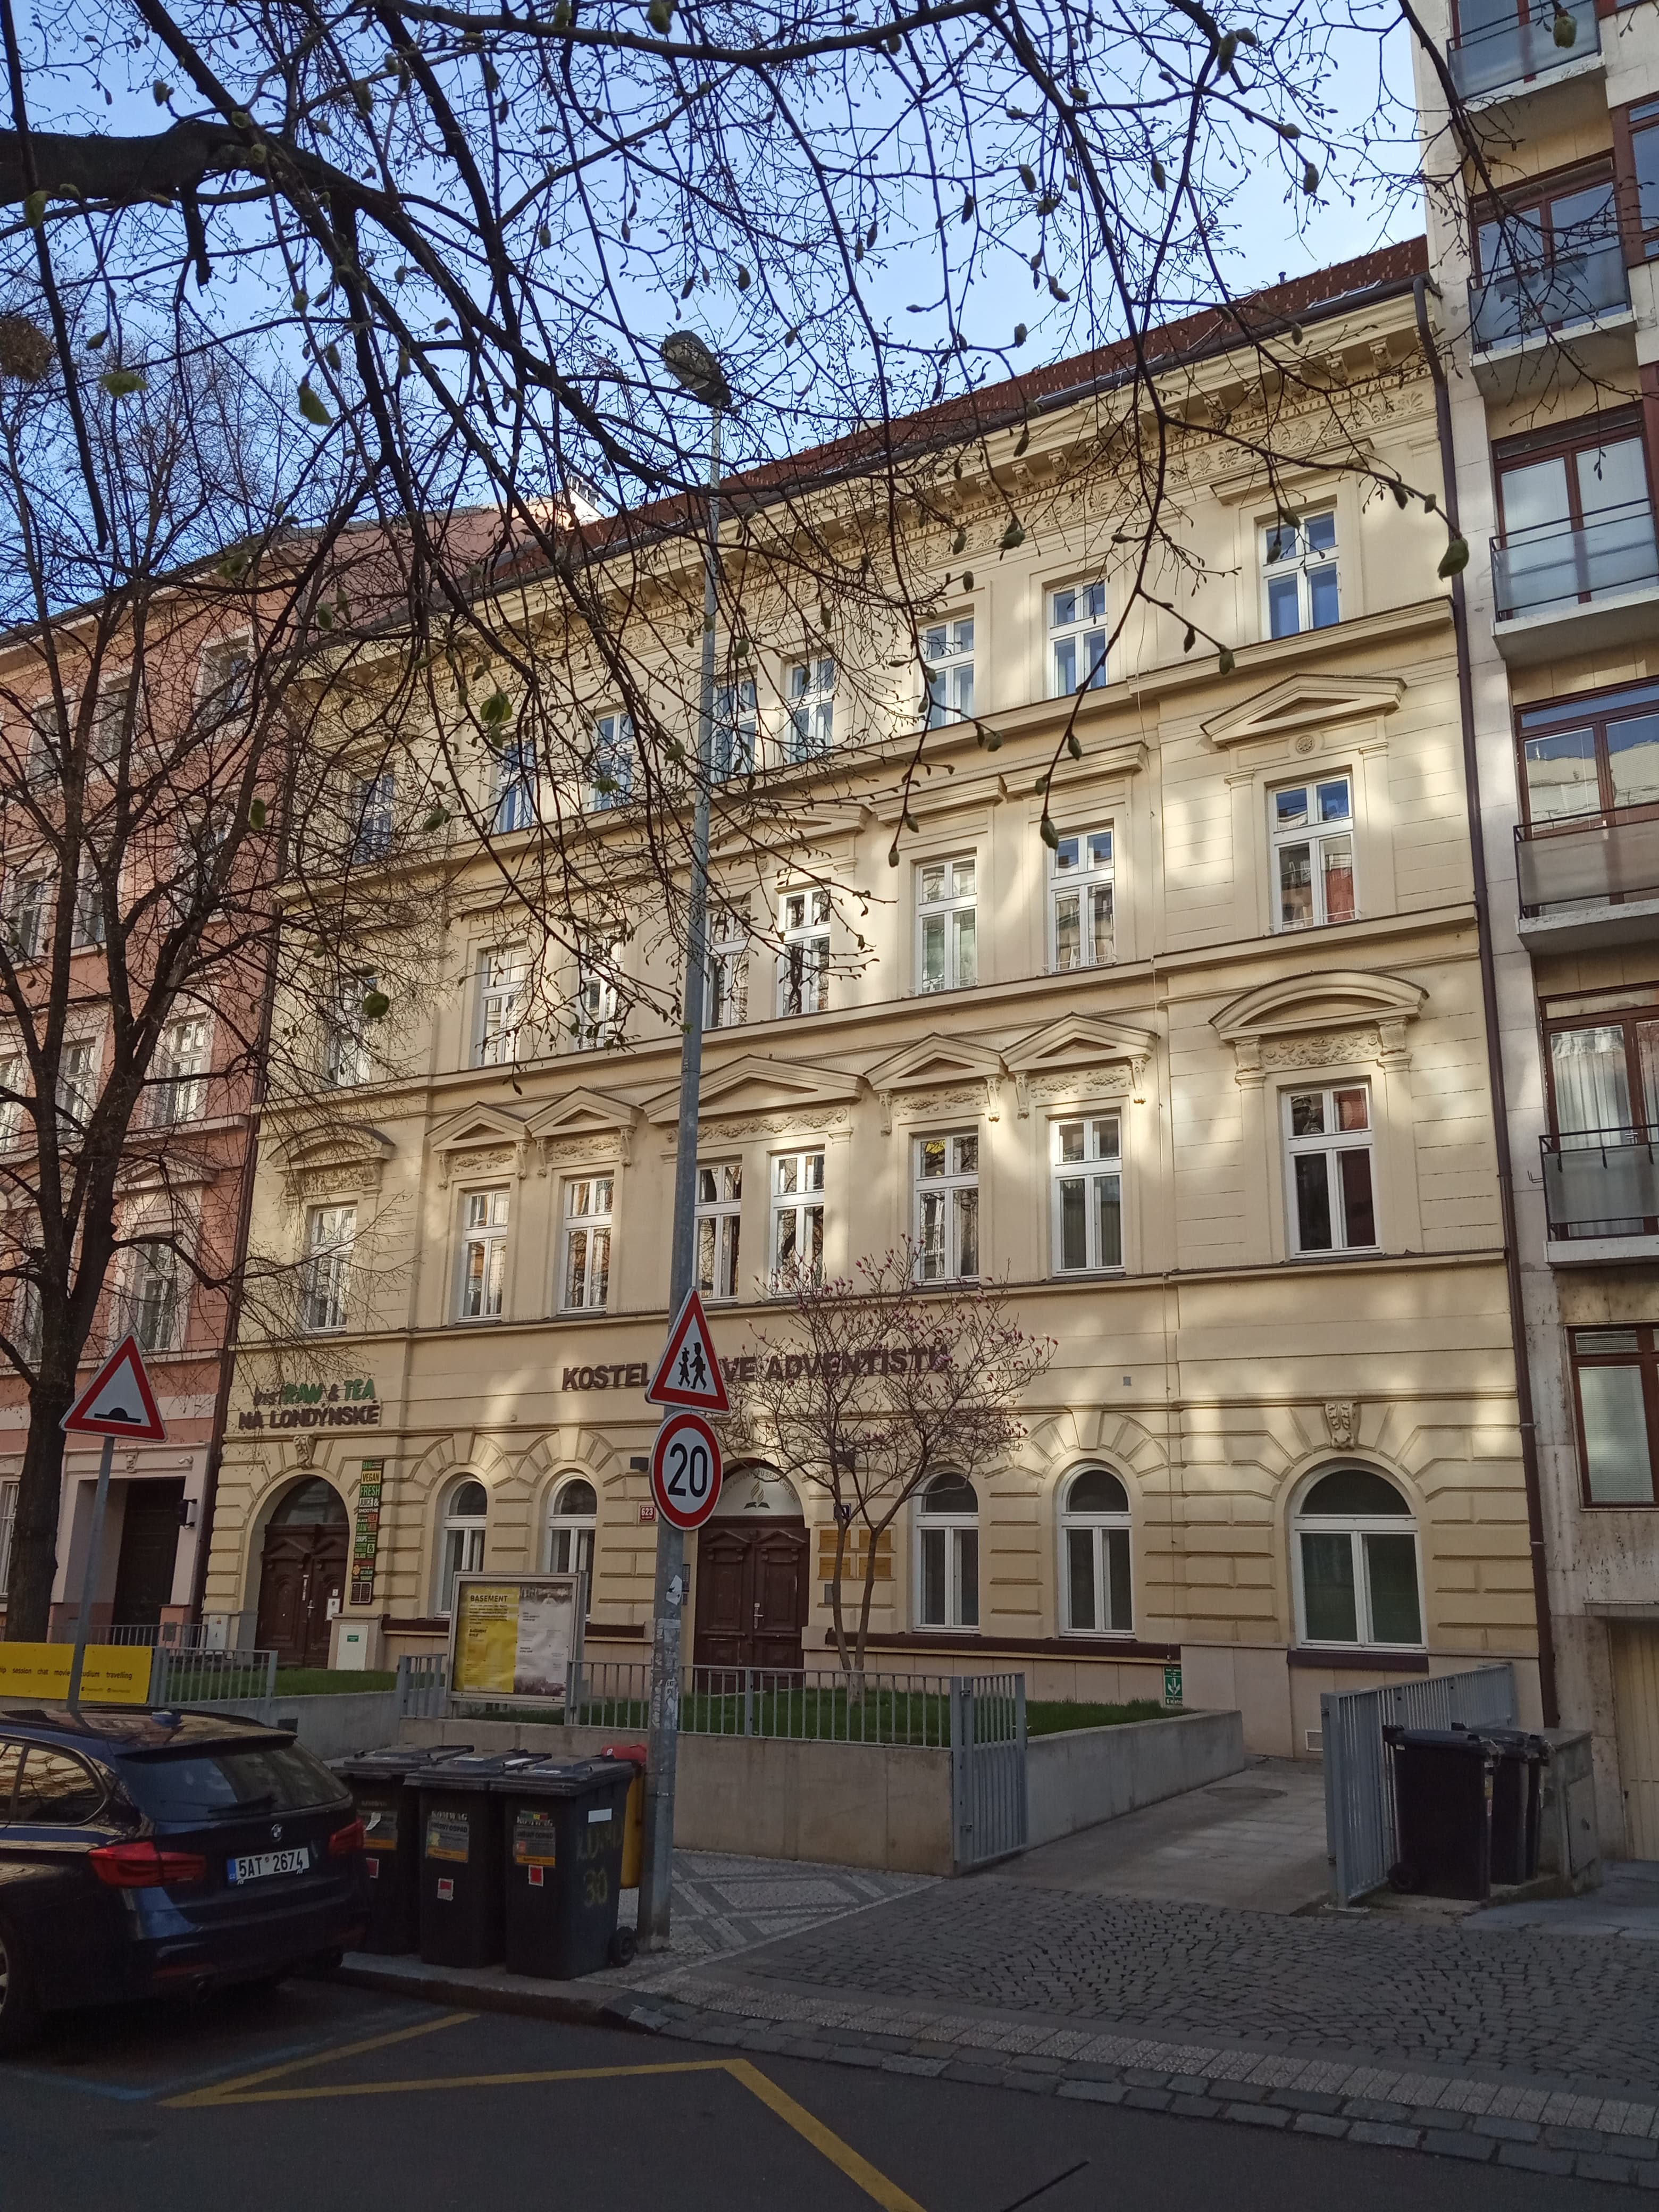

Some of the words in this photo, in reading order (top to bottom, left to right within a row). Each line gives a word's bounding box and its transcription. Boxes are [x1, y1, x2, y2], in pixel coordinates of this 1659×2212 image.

[562, 1362, 650, 1390] KOSTEL
[329, 1384, 339, 1402] &
[343, 1379, 375, 1401] TEA
[239, 1411, 263, 1430] NA
[269, 1400, 381, 1428] LONDÝNSKÉ
[668, 1443, 708, 1498] 20
[363, 1473, 380, 1482] VEGAN
[360, 1485, 380, 1497] FRESH
[359, 1498, 372, 1506] JUICE
[373, 1498, 379, 1506] &
[641, 1507, 653, 1516] 623
[106, 1671, 132, 1680] travelling
[431, 1810, 468, 1821] KOMWAG
[239, 1856, 262, 1878] 5AT
[273, 1851, 304, 1872] 2674
